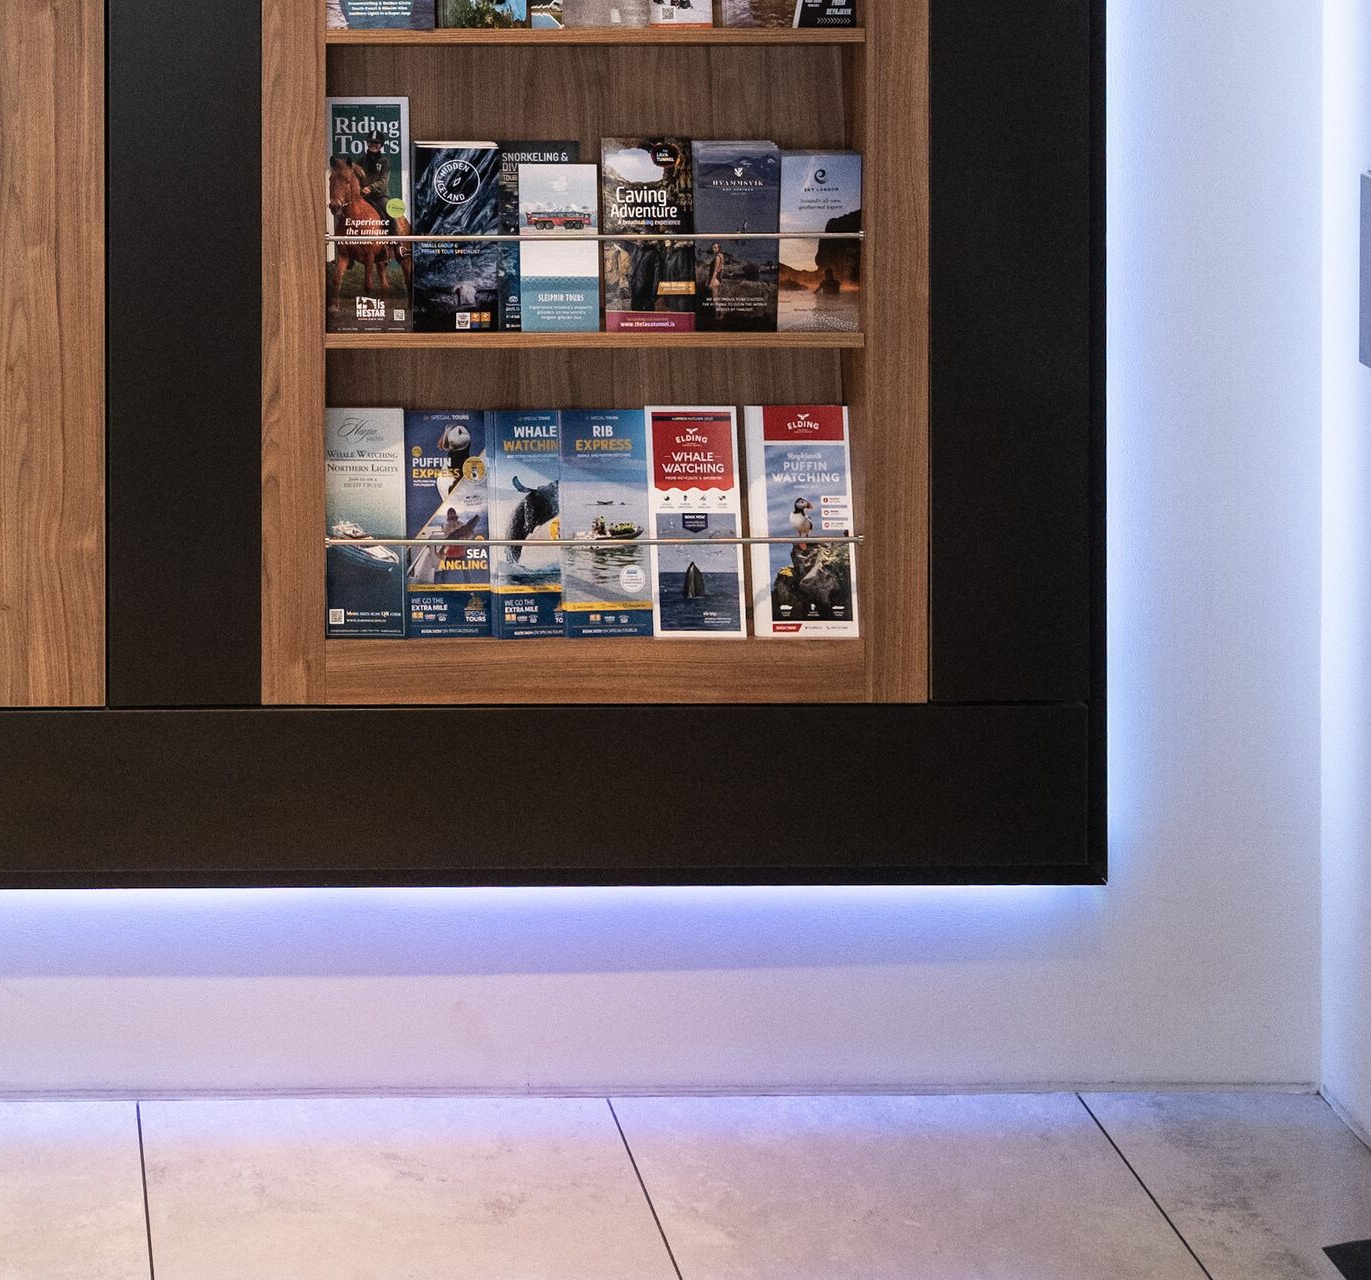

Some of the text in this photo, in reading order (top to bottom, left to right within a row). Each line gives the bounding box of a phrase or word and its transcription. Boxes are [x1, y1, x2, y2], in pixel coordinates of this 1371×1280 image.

[335, 116, 400, 138] Riding
[335, 135, 400, 154] Tors
[502, 152, 568, 162] SNORKELING &
[440, 162, 470, 177] HIDDEN
[437, 180, 465, 201] ICELAND
[616, 186, 667, 207] Caving
[610, 203, 678, 218] Adventure
[345, 218, 390, 227] Experience
[346, 227, 389, 236] the unique
[356, 309, 385, 317] HESTAR
[787, 421, 819, 430] ELDING
[514, 426, 557, 438] WHALE
[592, 426, 613, 437] RIB
[675, 434, 708, 443] ELDING
[503, 440, 558, 451] WATCHIN
[576, 440, 632, 451] EXPRESS
[671, 452, 714, 462] WHALE
[412, 458, 452, 467] PUFFIN
[783, 461, 827, 471] PUFFIN
[412, 468, 460, 478] EXPRESS
[662, 463, 724, 473] WATCHING
[772, 473, 840, 482] WATCHING
[466, 549, 487, 558] SEA
[439, 560, 487, 570] ANGLING
